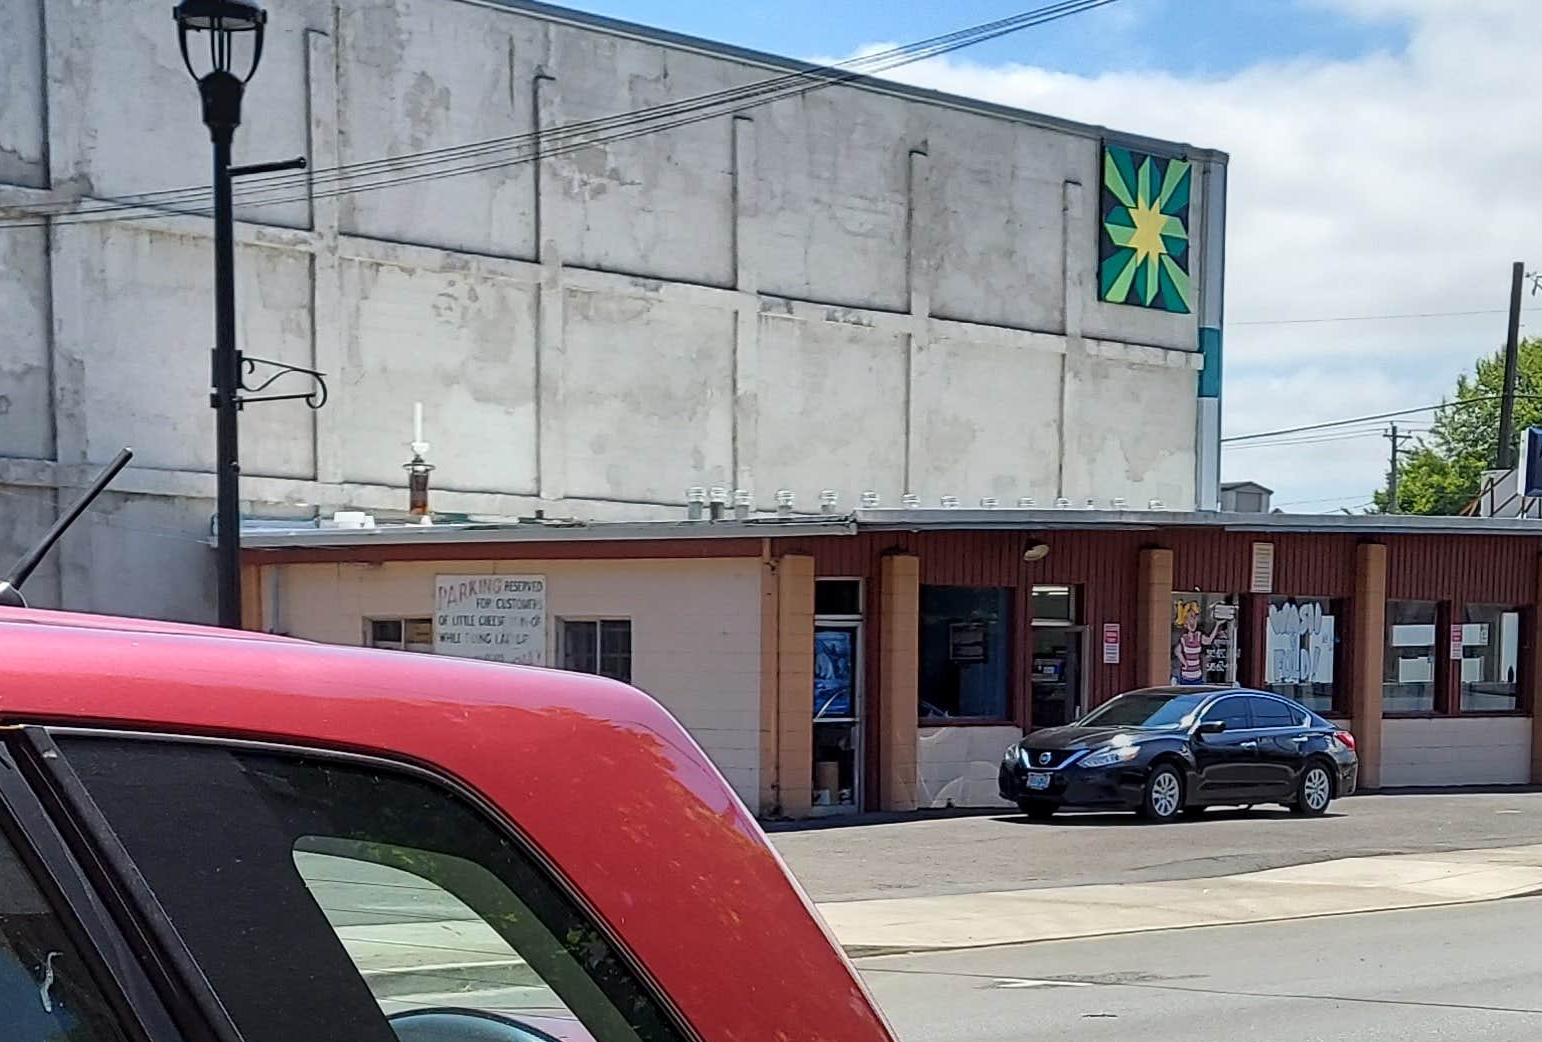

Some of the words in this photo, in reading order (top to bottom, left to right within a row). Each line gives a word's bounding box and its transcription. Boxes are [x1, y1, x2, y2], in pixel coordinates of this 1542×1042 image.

[438, 578, 502, 609] PARKING
[504, 581, 543, 592] RESERVED
[476, 598, 492, 609] FOR
[439, 615, 449, 626] OF
[452, 614, 476, 626] LITTLE
